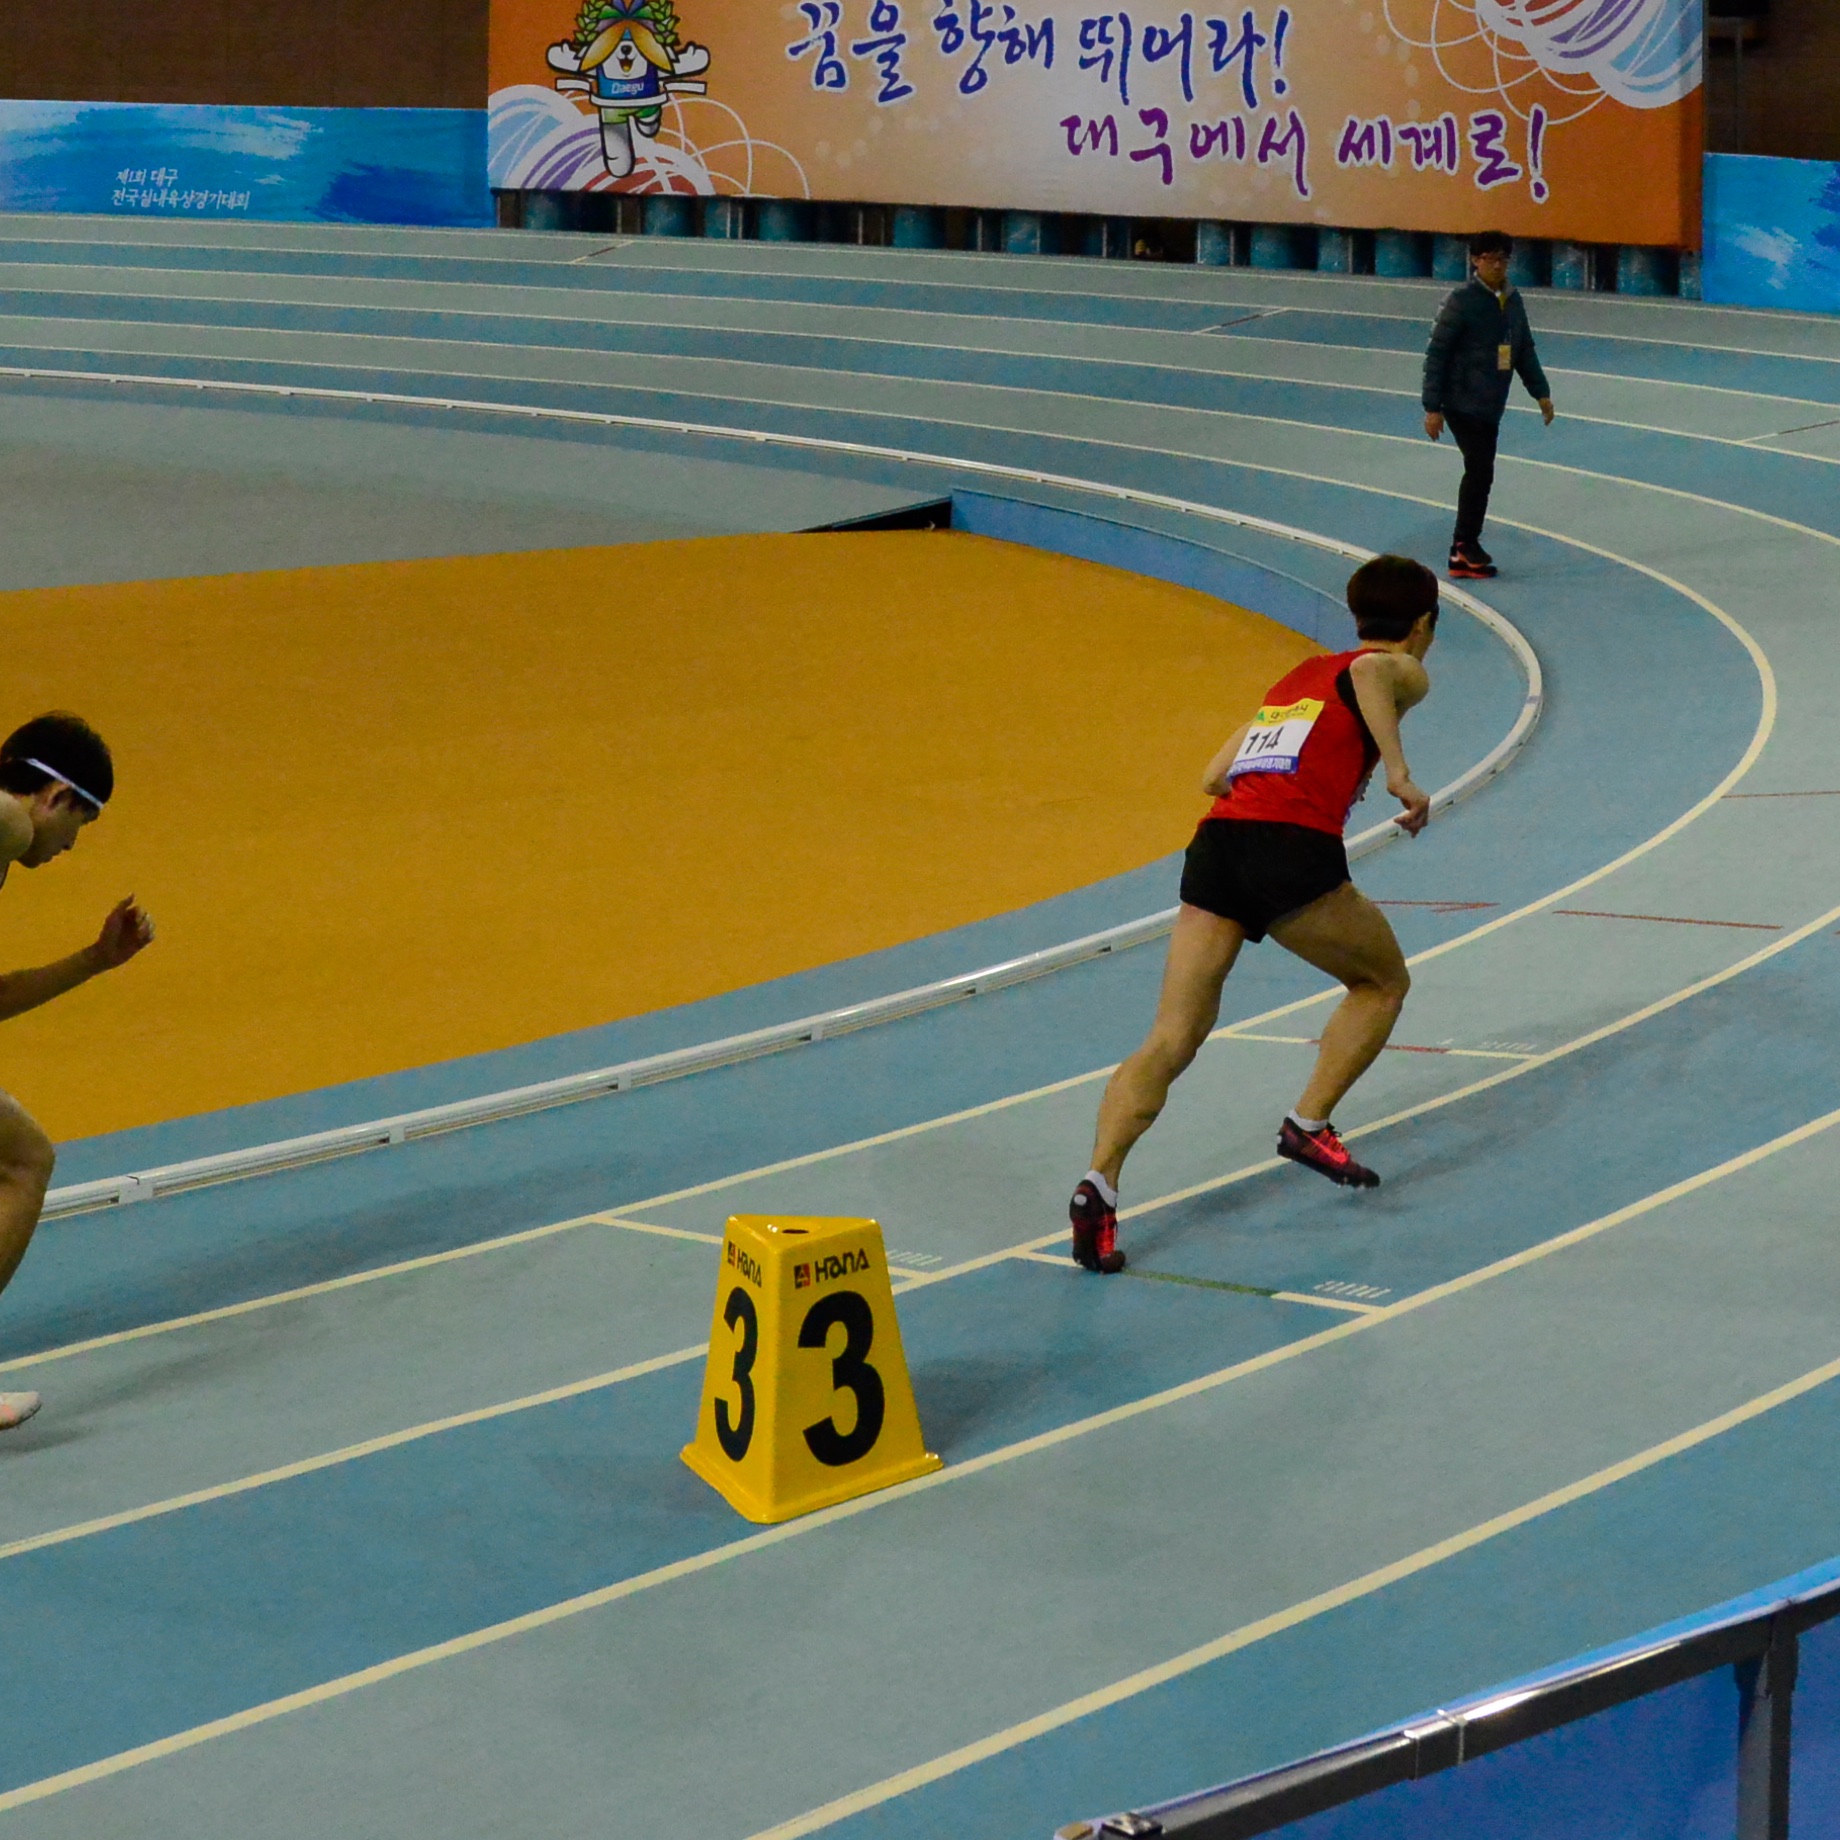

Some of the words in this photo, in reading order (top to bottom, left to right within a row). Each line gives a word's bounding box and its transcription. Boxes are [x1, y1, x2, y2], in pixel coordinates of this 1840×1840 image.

[790, 0, 913, 103] 꿈을
[1078, 10, 1289, 109] 뛰어라!
[611, 82, 645, 95] Daegu
[150, 167, 179, 187] 대구
[1059, 107, 1309, 197] 대구에서
[1337, 106, 1548, 205] 세계로!
[111, 187, 251, 211] 전국실내육상경기대회
[1244, 726, 1284, 755] 114
[714, 1286, 758, 1462] 3
[798, 1290, 886, 1467] 3
